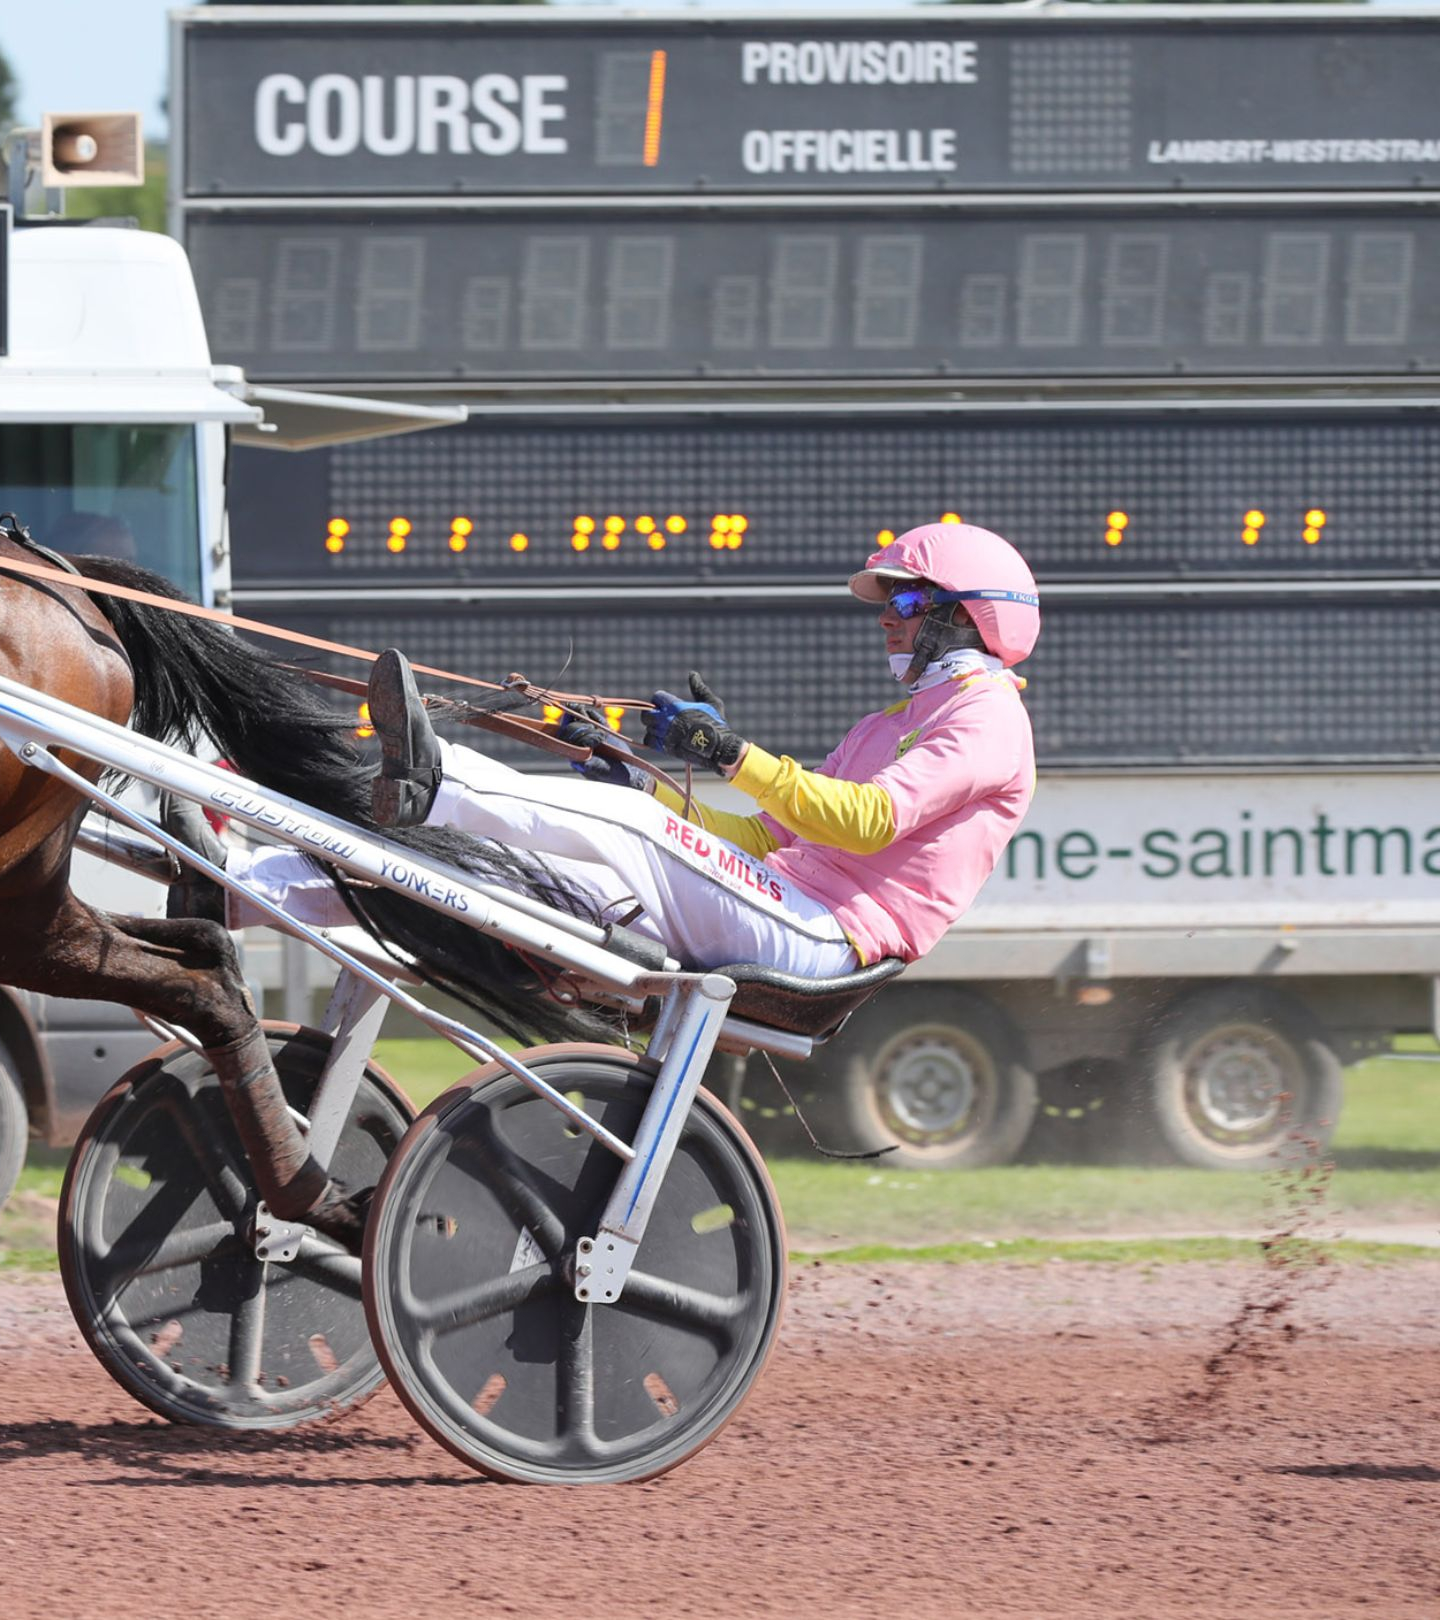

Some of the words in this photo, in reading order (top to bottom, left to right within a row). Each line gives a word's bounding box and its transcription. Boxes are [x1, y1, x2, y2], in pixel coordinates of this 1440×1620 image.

[742, 41, 976, 84] PROVISOIRE
[255, 74, 568, 156] COURSE
[742, 130, 955, 173] OFFICIELLE
[1148, 139, 1440, 163] LAMBERT-WESTERSTRA
[210, 786, 358, 859] CUSTOM
[378, 860, 469, 912] YONKERS
[665, 816, 711, 858] RED
[718, 849, 783, 902] MILLS
